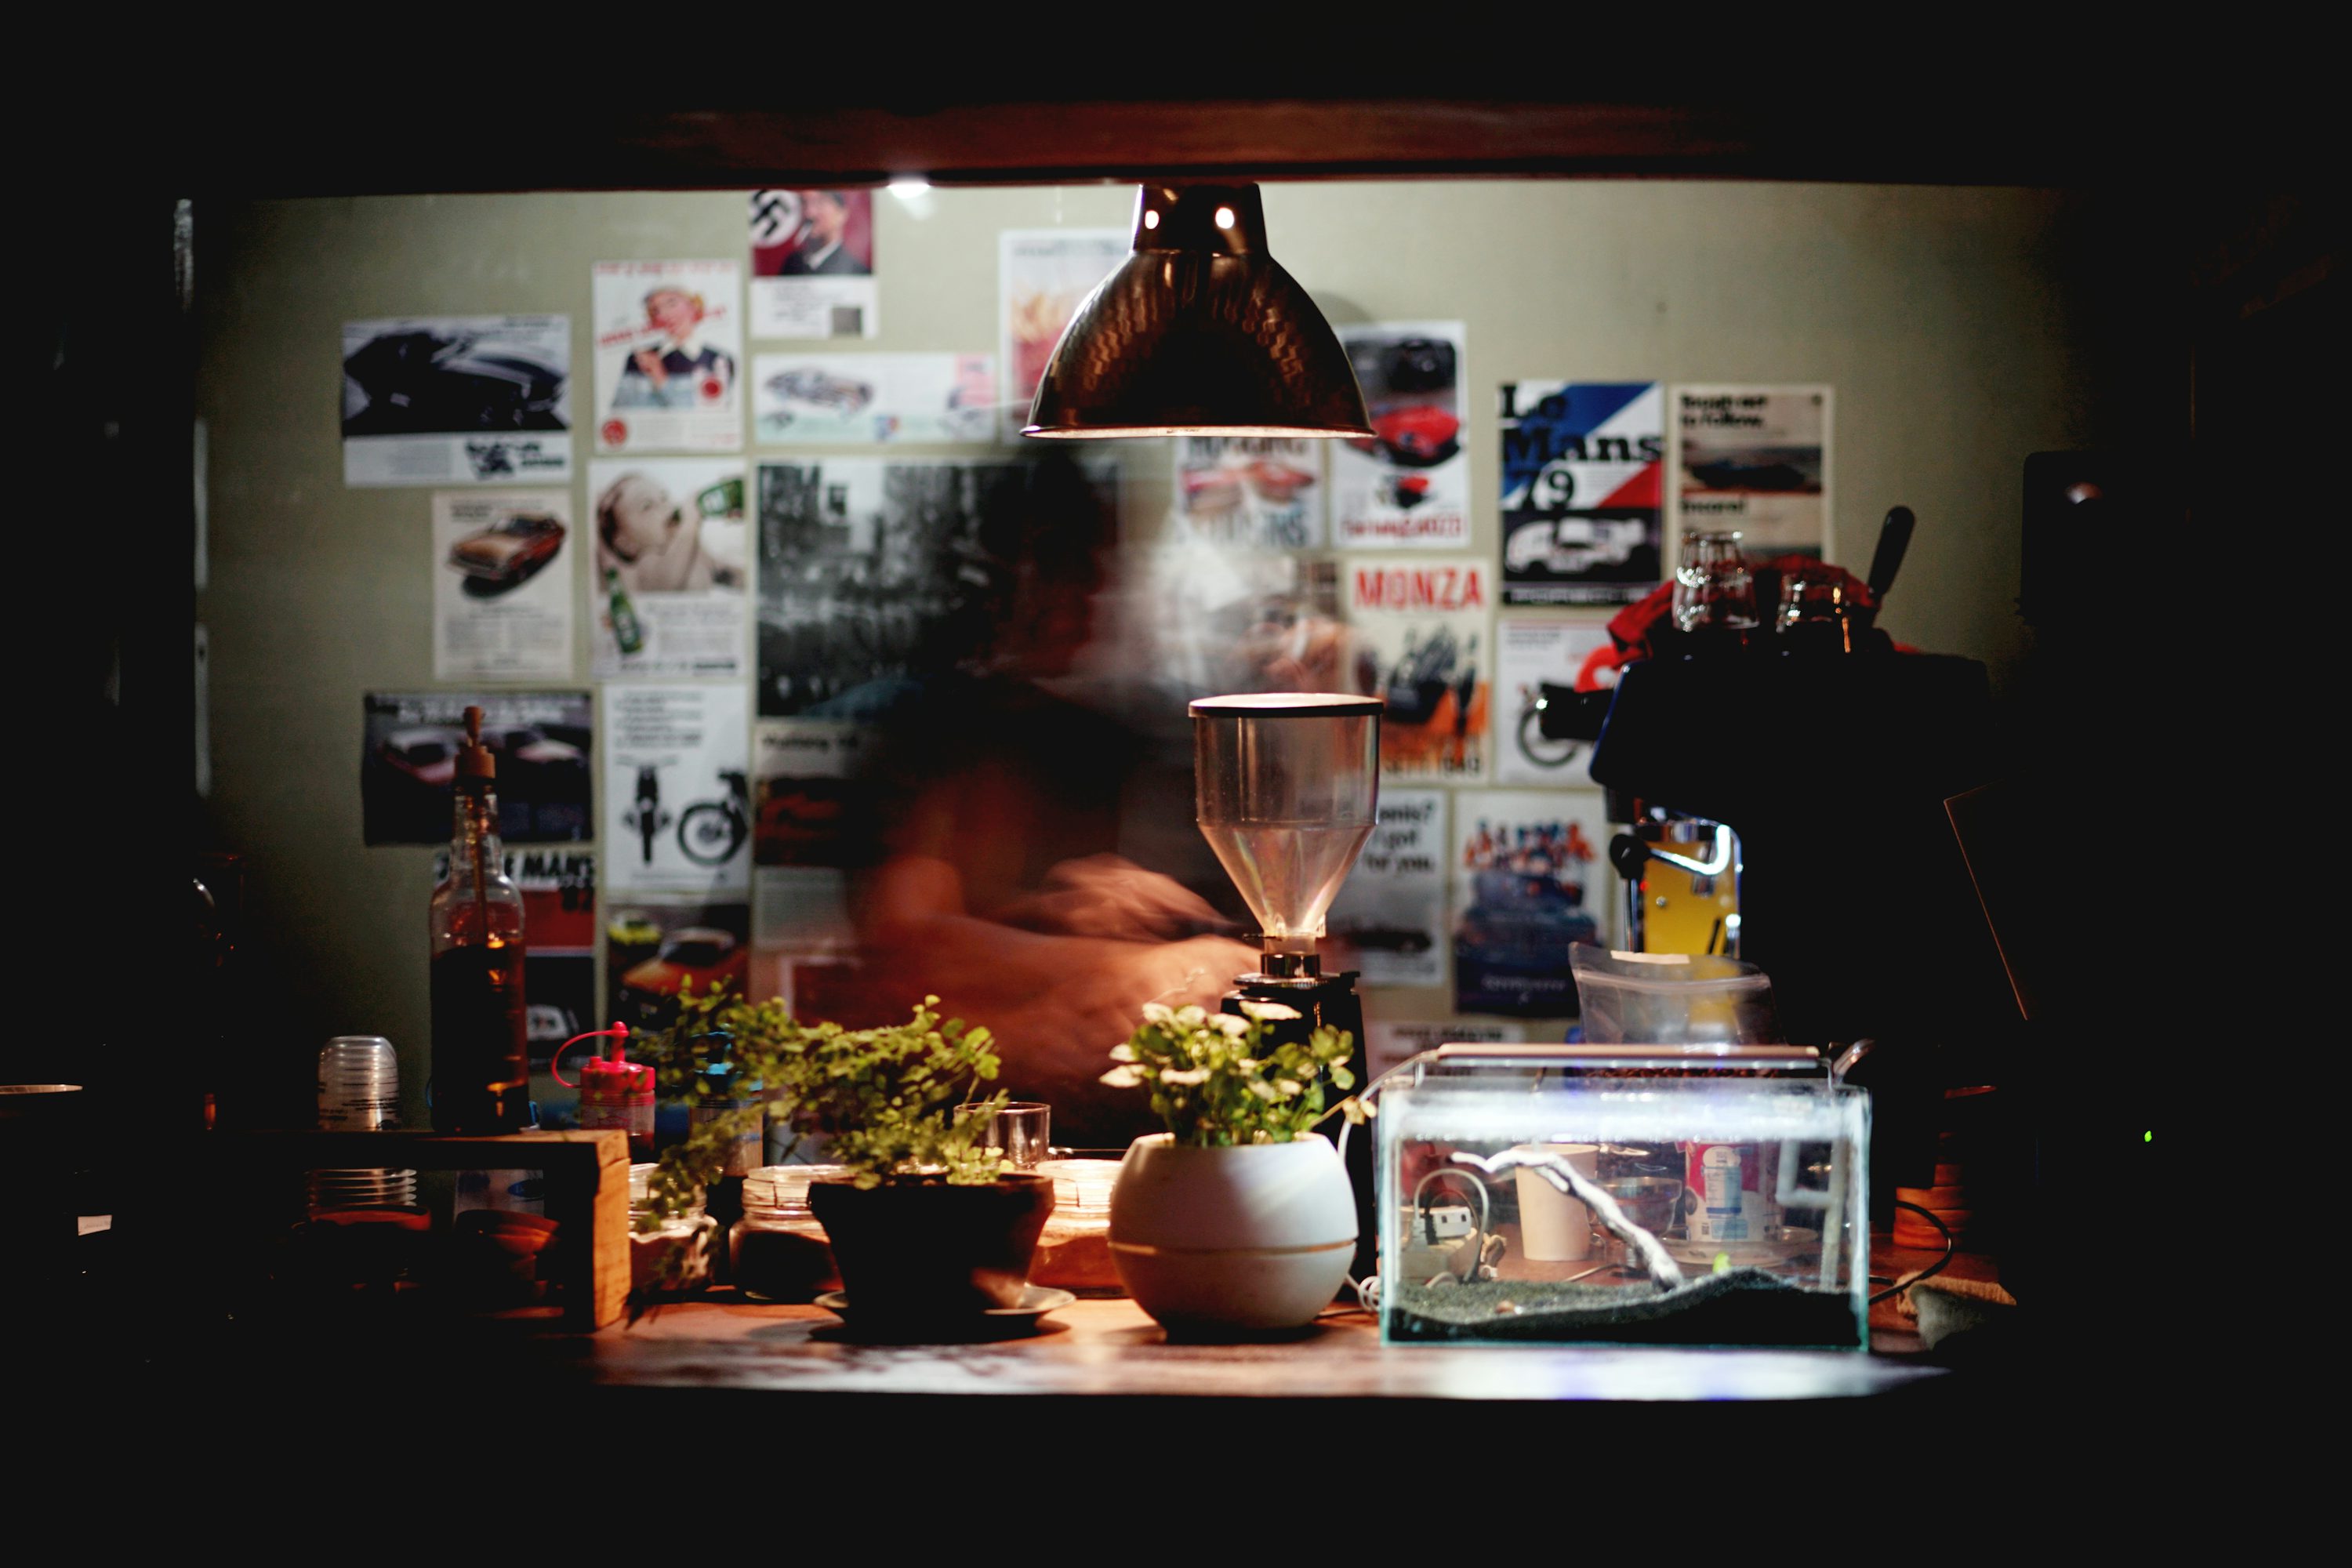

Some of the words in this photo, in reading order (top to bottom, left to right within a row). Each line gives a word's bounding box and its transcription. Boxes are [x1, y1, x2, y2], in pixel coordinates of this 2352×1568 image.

[1503, 385, 1567, 419] Le
[1503, 427, 1664, 463] Mans
[1355, 569, 1484, 609] MONZA
